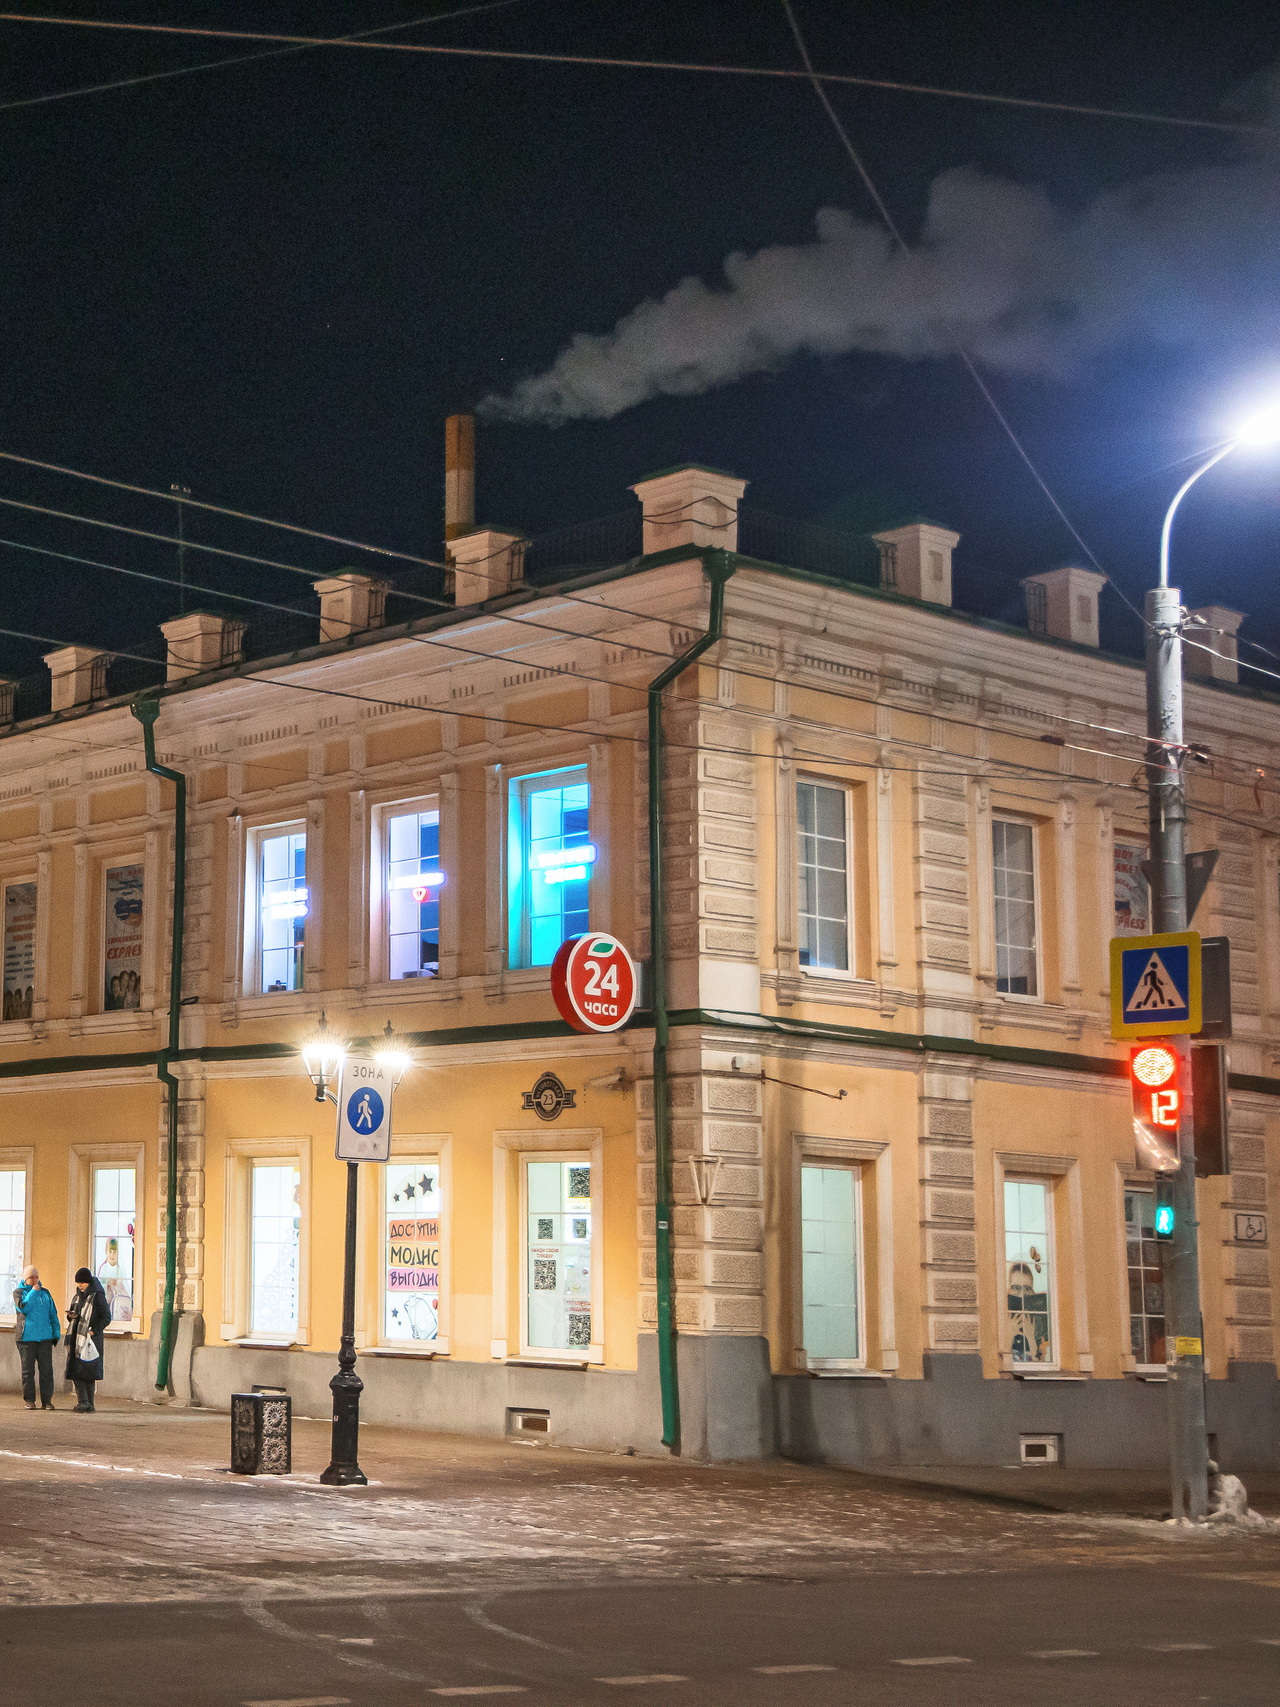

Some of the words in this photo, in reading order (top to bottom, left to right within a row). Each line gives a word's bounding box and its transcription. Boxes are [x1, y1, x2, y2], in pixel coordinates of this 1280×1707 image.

[1115, 862, 1139, 874] АКЕТ
[1116, 915, 1146, 930] PRESS
[106, 943, 142, 960] EXPRES
[583, 960, 620, 999] 24
[584, 1001, 618, 1017] часа
[353, 1066, 384, 1079] ЗОНА
[543, 1094, 554, 1106] 23
[1151, 1090, 1179, 1126] 12
[390, 1222, 438, 1239] ДОСТУПН
